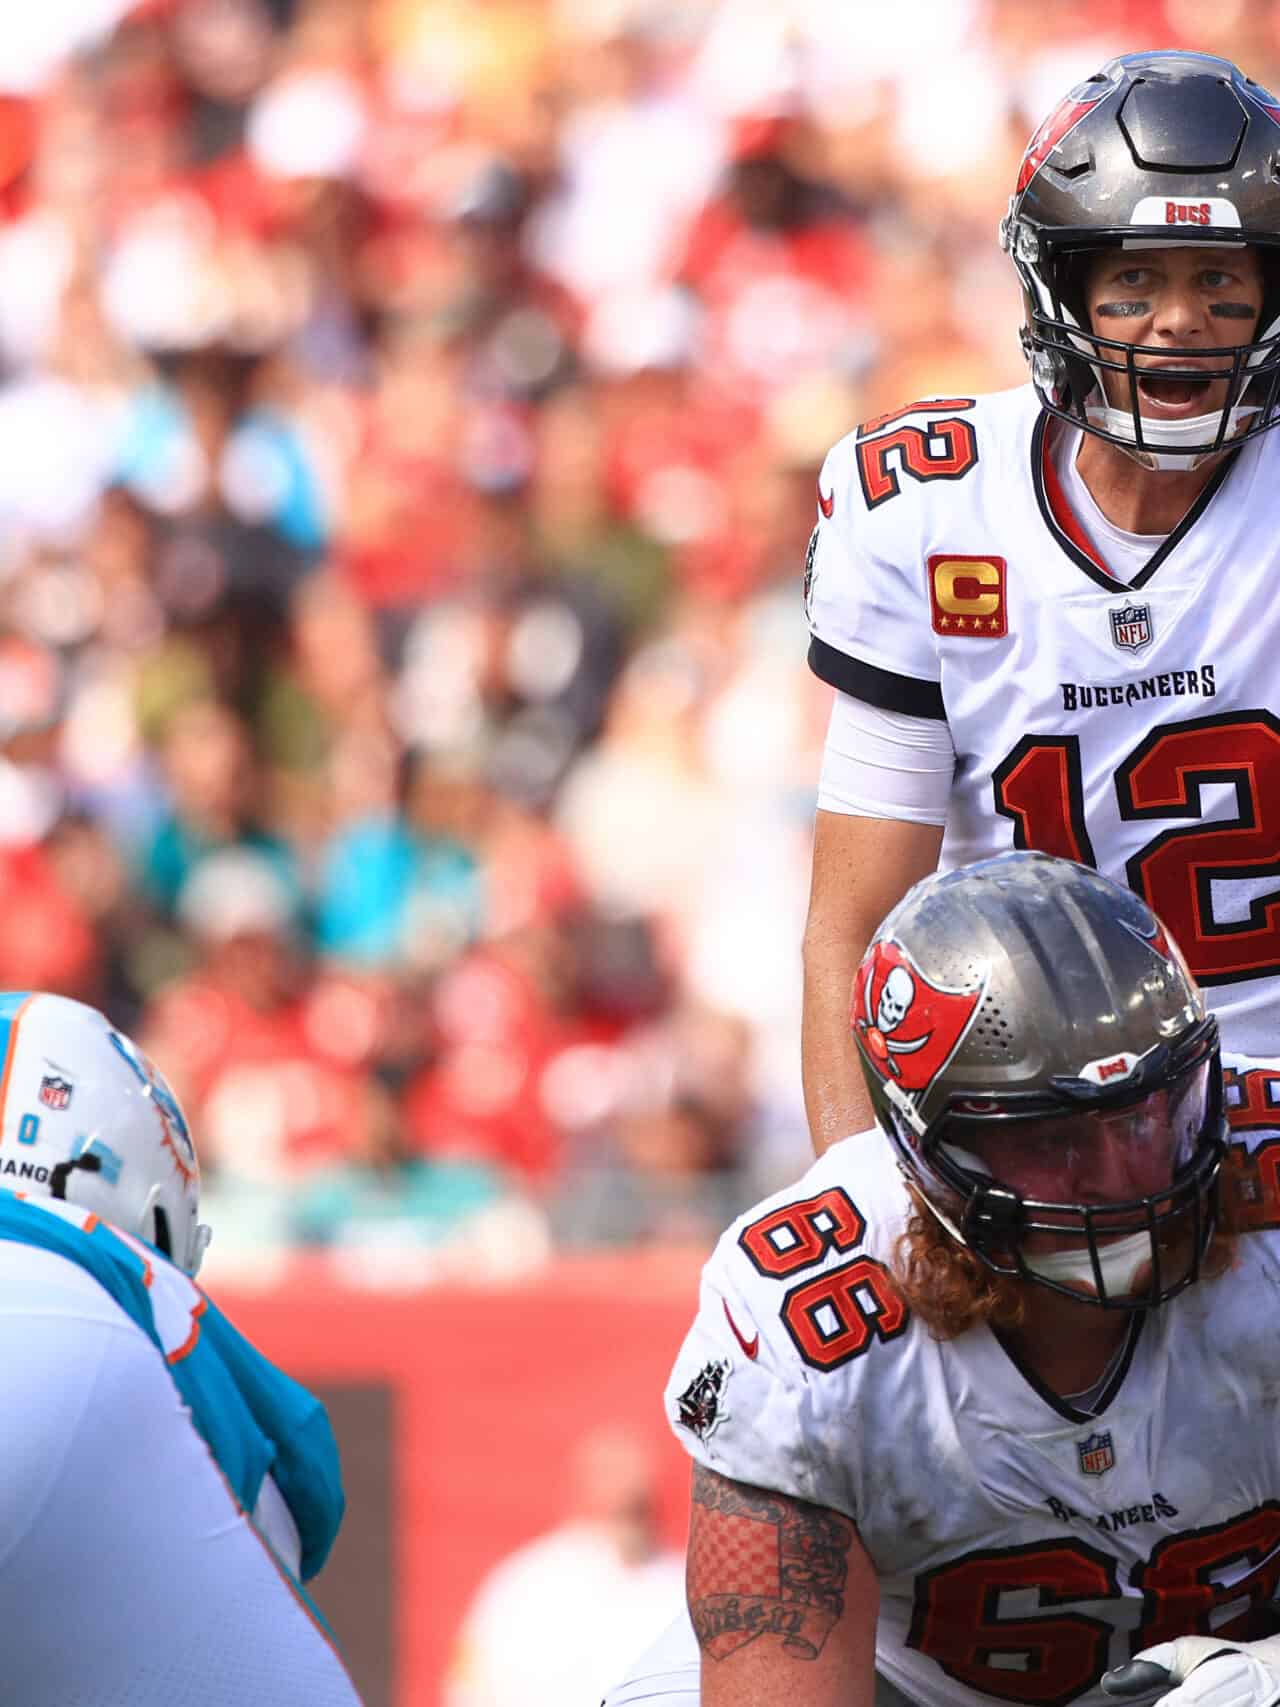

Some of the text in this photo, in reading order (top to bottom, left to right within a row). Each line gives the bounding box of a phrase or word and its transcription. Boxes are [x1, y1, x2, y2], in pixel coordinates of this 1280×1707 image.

[1165, 201, 1211, 225] BUCS
[934, 561, 999, 615] C
[1118, 622, 1148, 644] NFL
[1059, 664, 1216, 711] BUCCANEERS
[737, 1185, 911, 1374] 66
[1083, 1447, 1114, 1472] NFL
